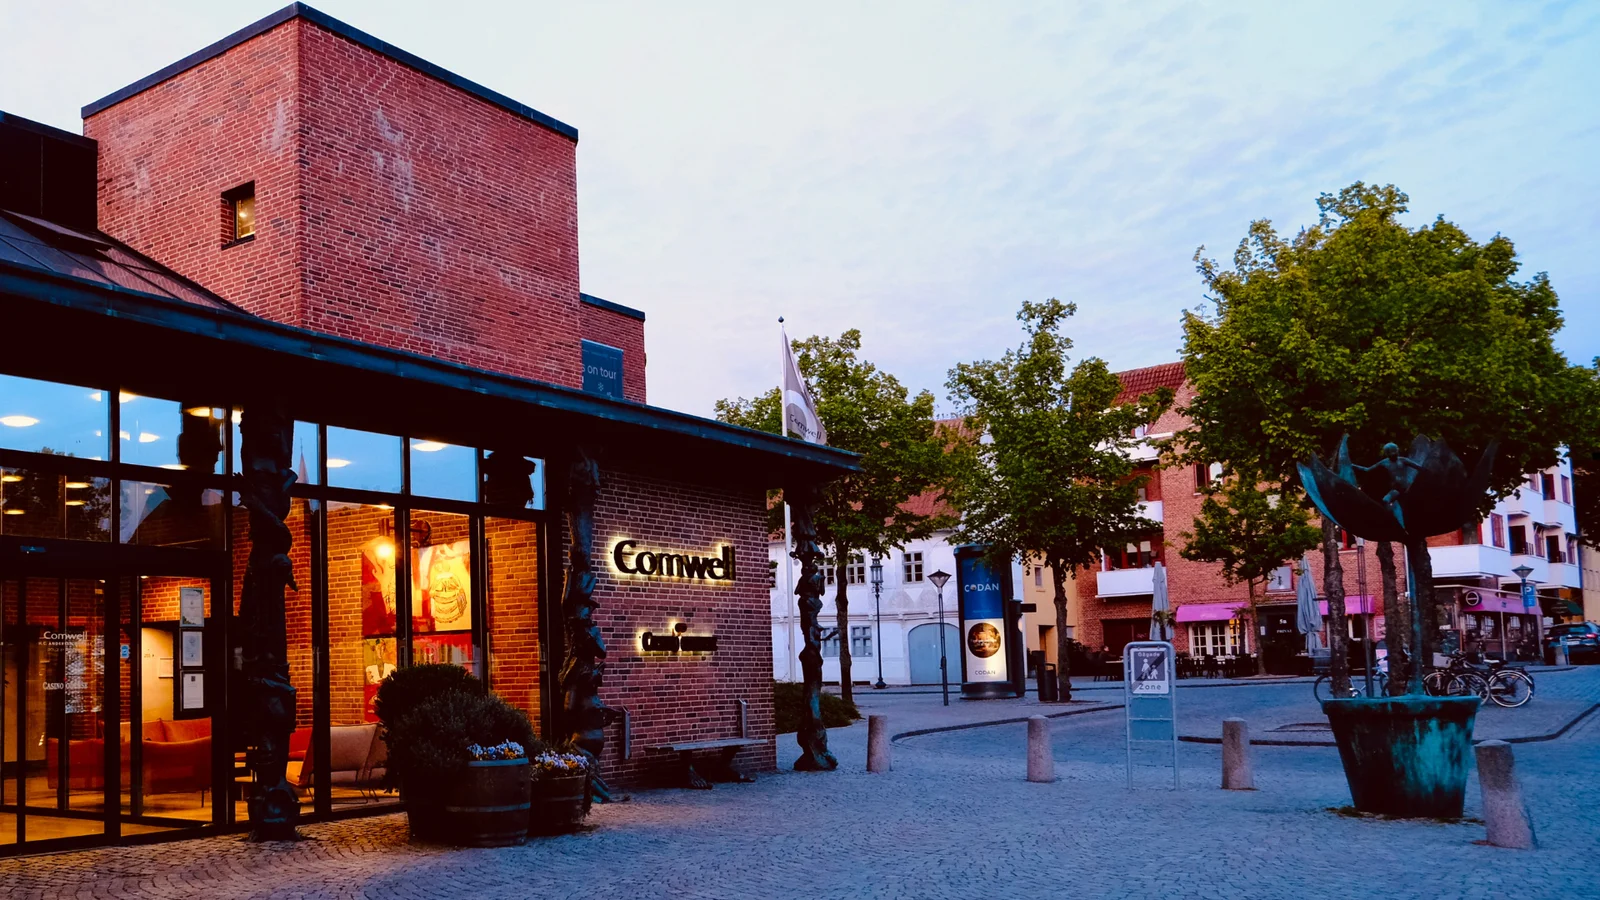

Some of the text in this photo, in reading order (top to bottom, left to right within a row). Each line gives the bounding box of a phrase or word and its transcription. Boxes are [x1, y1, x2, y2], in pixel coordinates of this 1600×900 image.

[587, 365, 599, 375] on
[600, 367, 617, 380] tour
[613, 540, 737, 580] Comwell
[1524, 586, 1532, 595] P
[43, 631, 88, 640] Comwell
[1138, 683, 1162, 691] Zone
